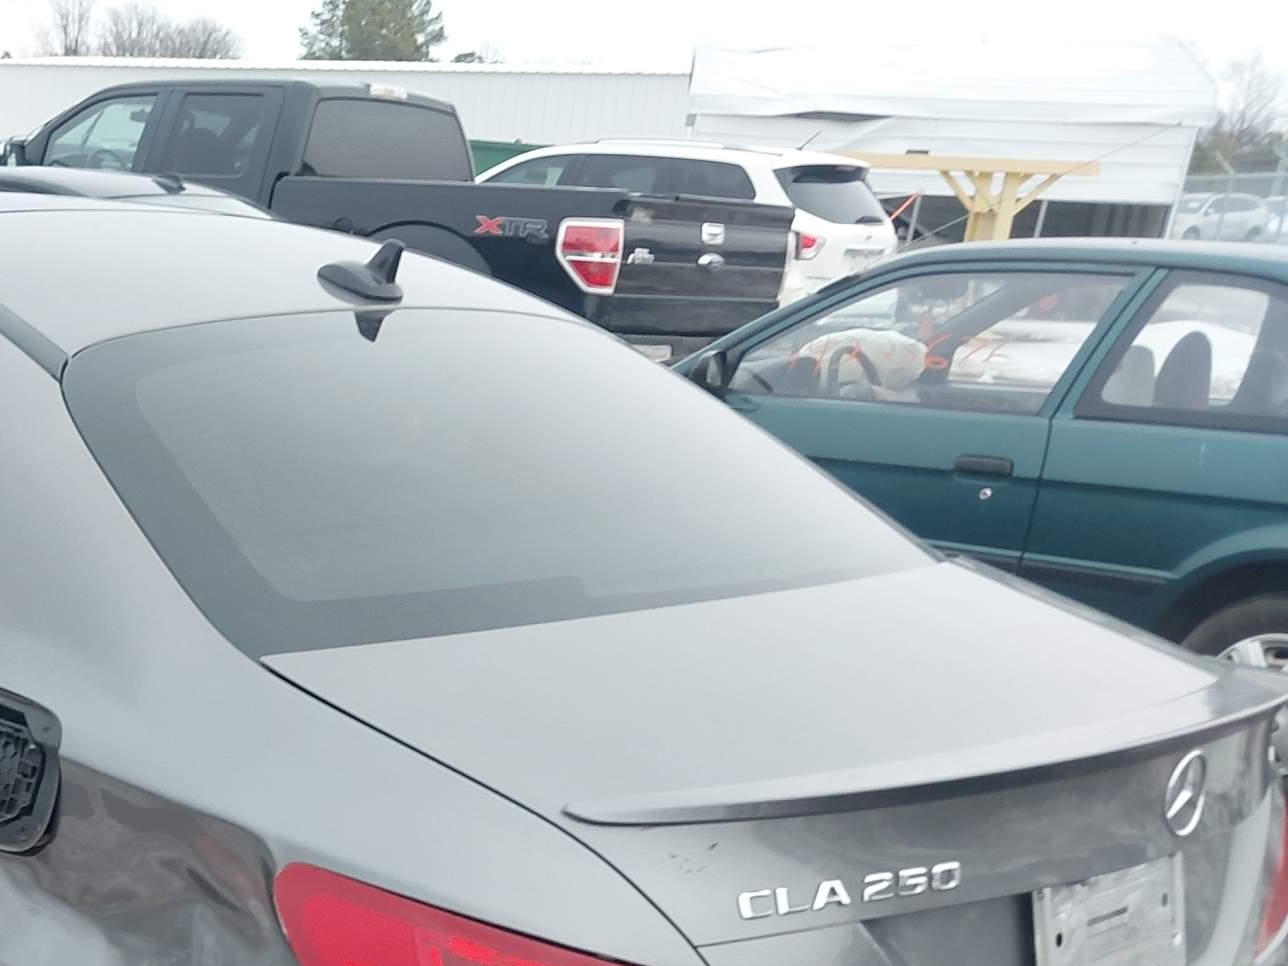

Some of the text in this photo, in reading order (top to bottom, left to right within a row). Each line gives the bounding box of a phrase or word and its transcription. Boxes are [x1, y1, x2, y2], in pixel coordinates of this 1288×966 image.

[473, 215, 549, 238] XTR
[737, 860, 961, 920] CLA 250
